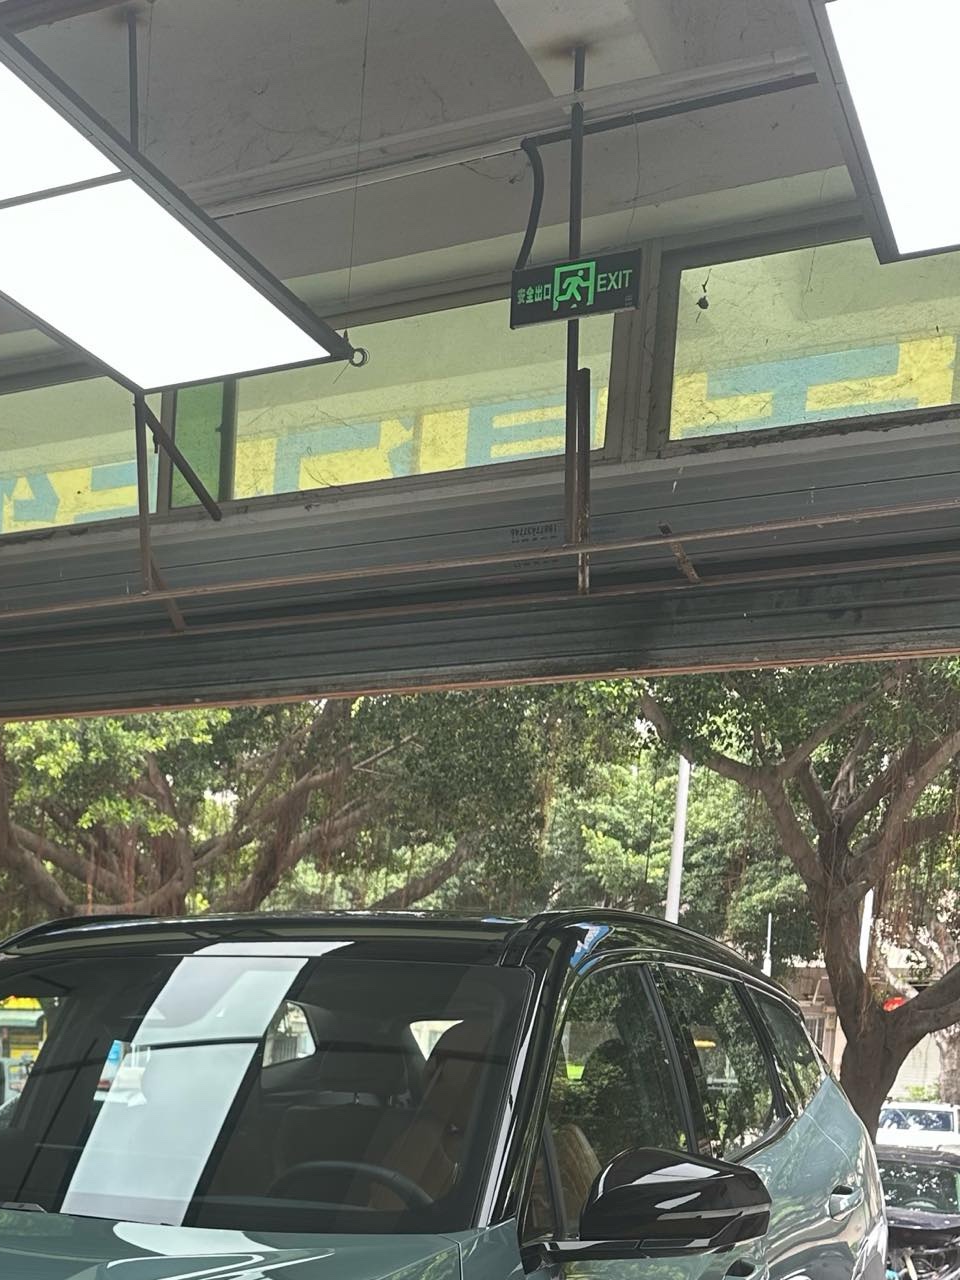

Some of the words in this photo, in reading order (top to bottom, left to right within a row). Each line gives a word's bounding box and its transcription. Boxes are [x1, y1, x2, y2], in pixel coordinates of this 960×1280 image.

[517, 284, 552, 304] 安全出口
[597, 270, 632, 292] EXIT
